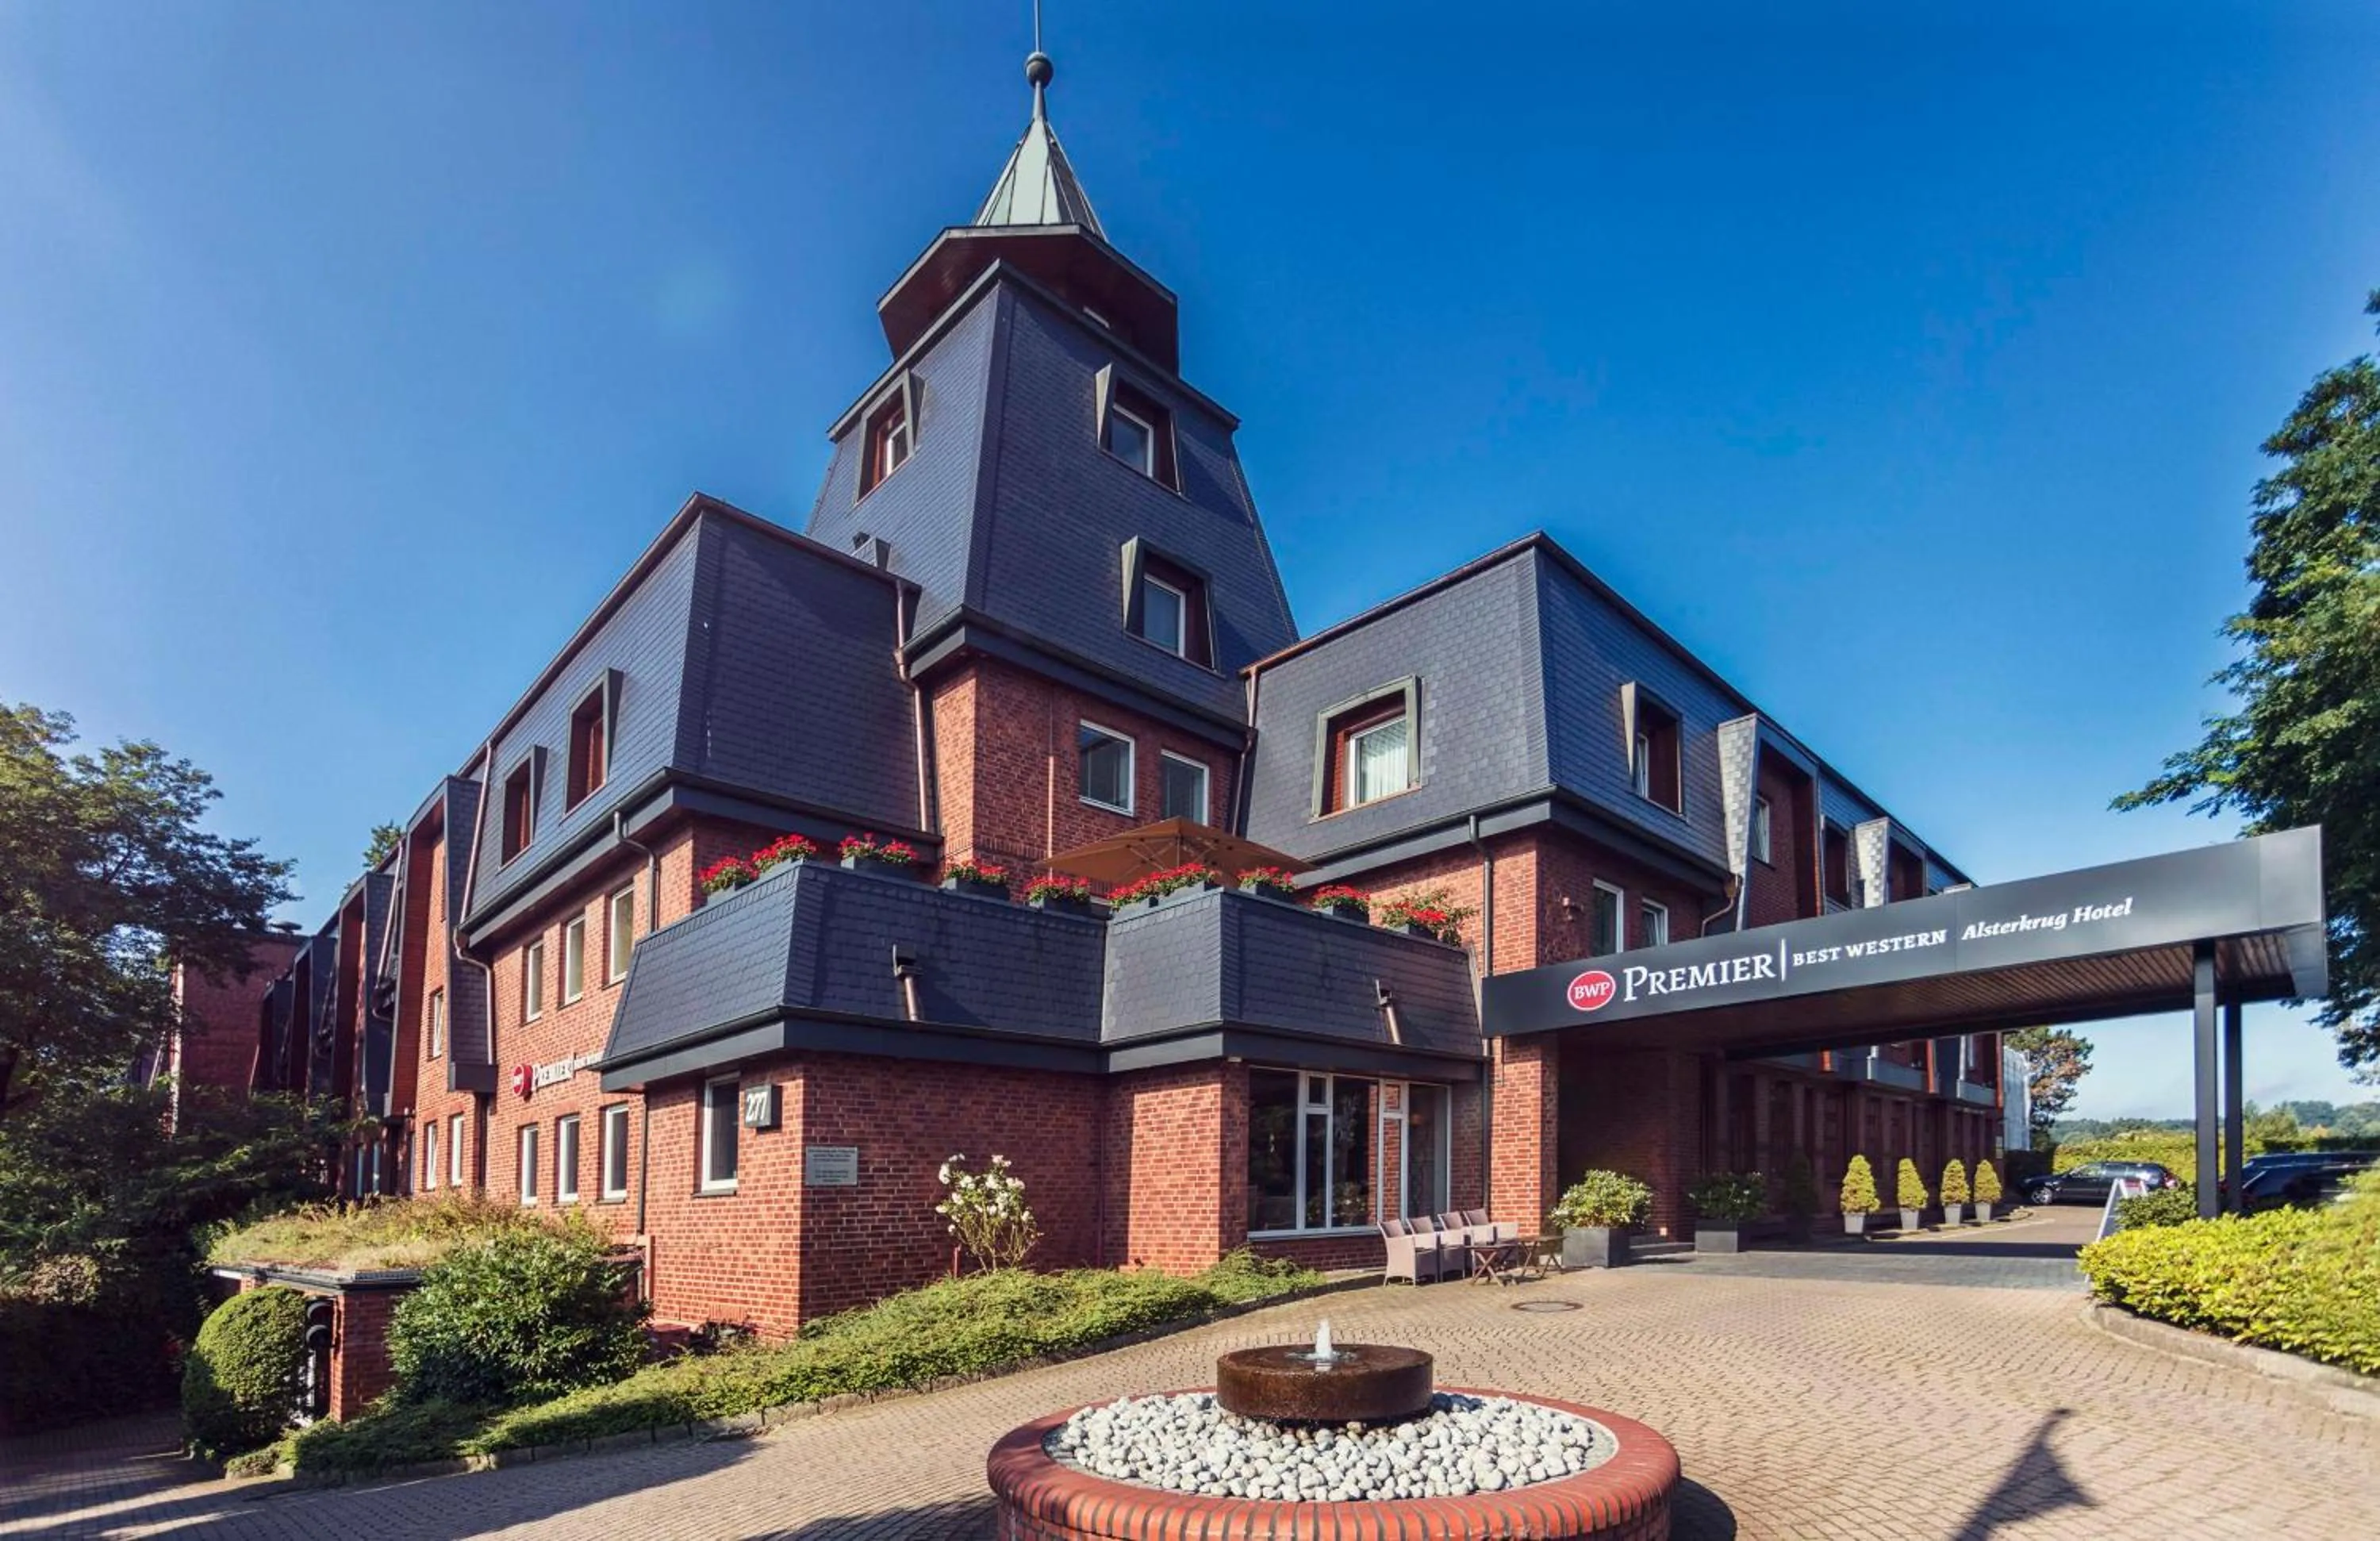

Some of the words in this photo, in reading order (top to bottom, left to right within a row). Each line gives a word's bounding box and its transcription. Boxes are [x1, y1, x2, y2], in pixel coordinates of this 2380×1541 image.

[1573, 982, 1610, 1001] BWP
[1623, 953, 1776, 1002] PREMIER
[1792, 947, 1842, 966] BEST
[1844, 929, 1948, 958] WESTERN
[1961, 913, 2068, 941] Alsterkrug
[2071, 897, 2133, 924] Hotel
[746, 1092, 767, 1122] 277
